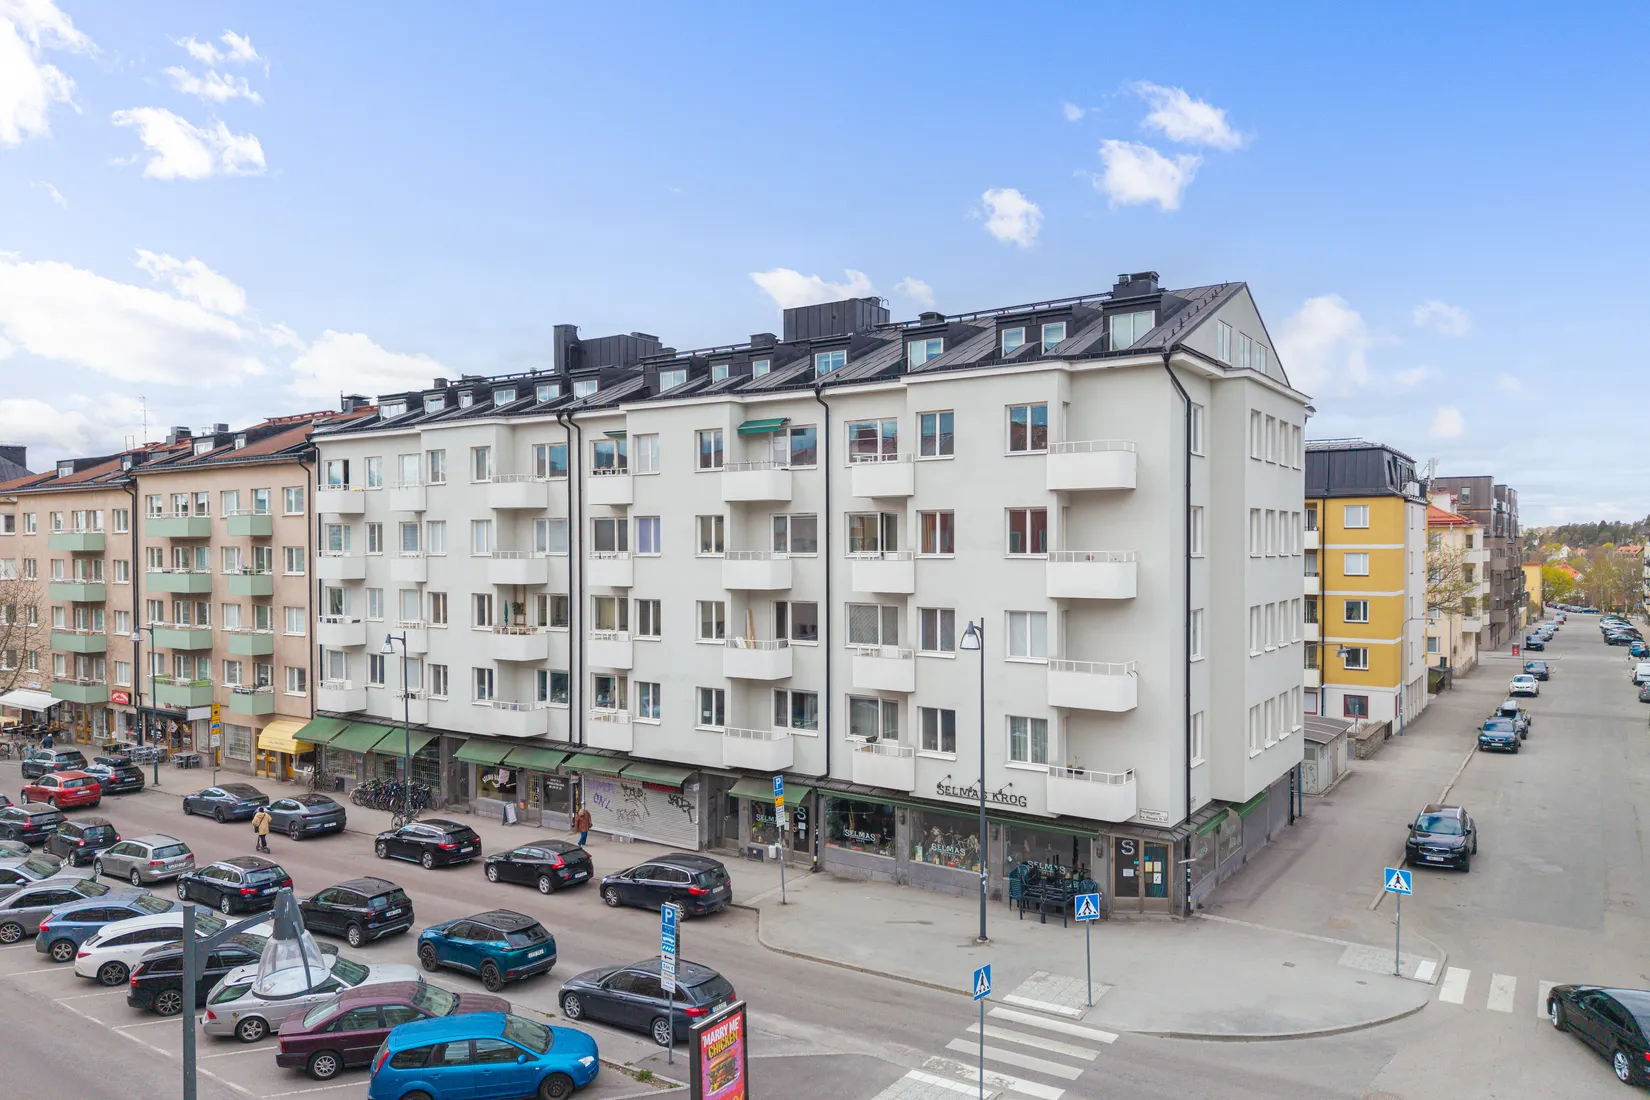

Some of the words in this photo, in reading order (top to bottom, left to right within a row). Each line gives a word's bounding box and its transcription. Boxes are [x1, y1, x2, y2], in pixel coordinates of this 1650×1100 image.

[776, 777, 781, 789] P
[992, 792, 1028, 808] KROG
[797, 807, 806, 820] S
[844, 829, 876, 842] SELMAS
[931, 842, 966, 857] SELMAS
[1121, 840, 1135, 855] S
[665, 908, 673, 923] P
[707, 1030, 738, 1059] CHICKEN
